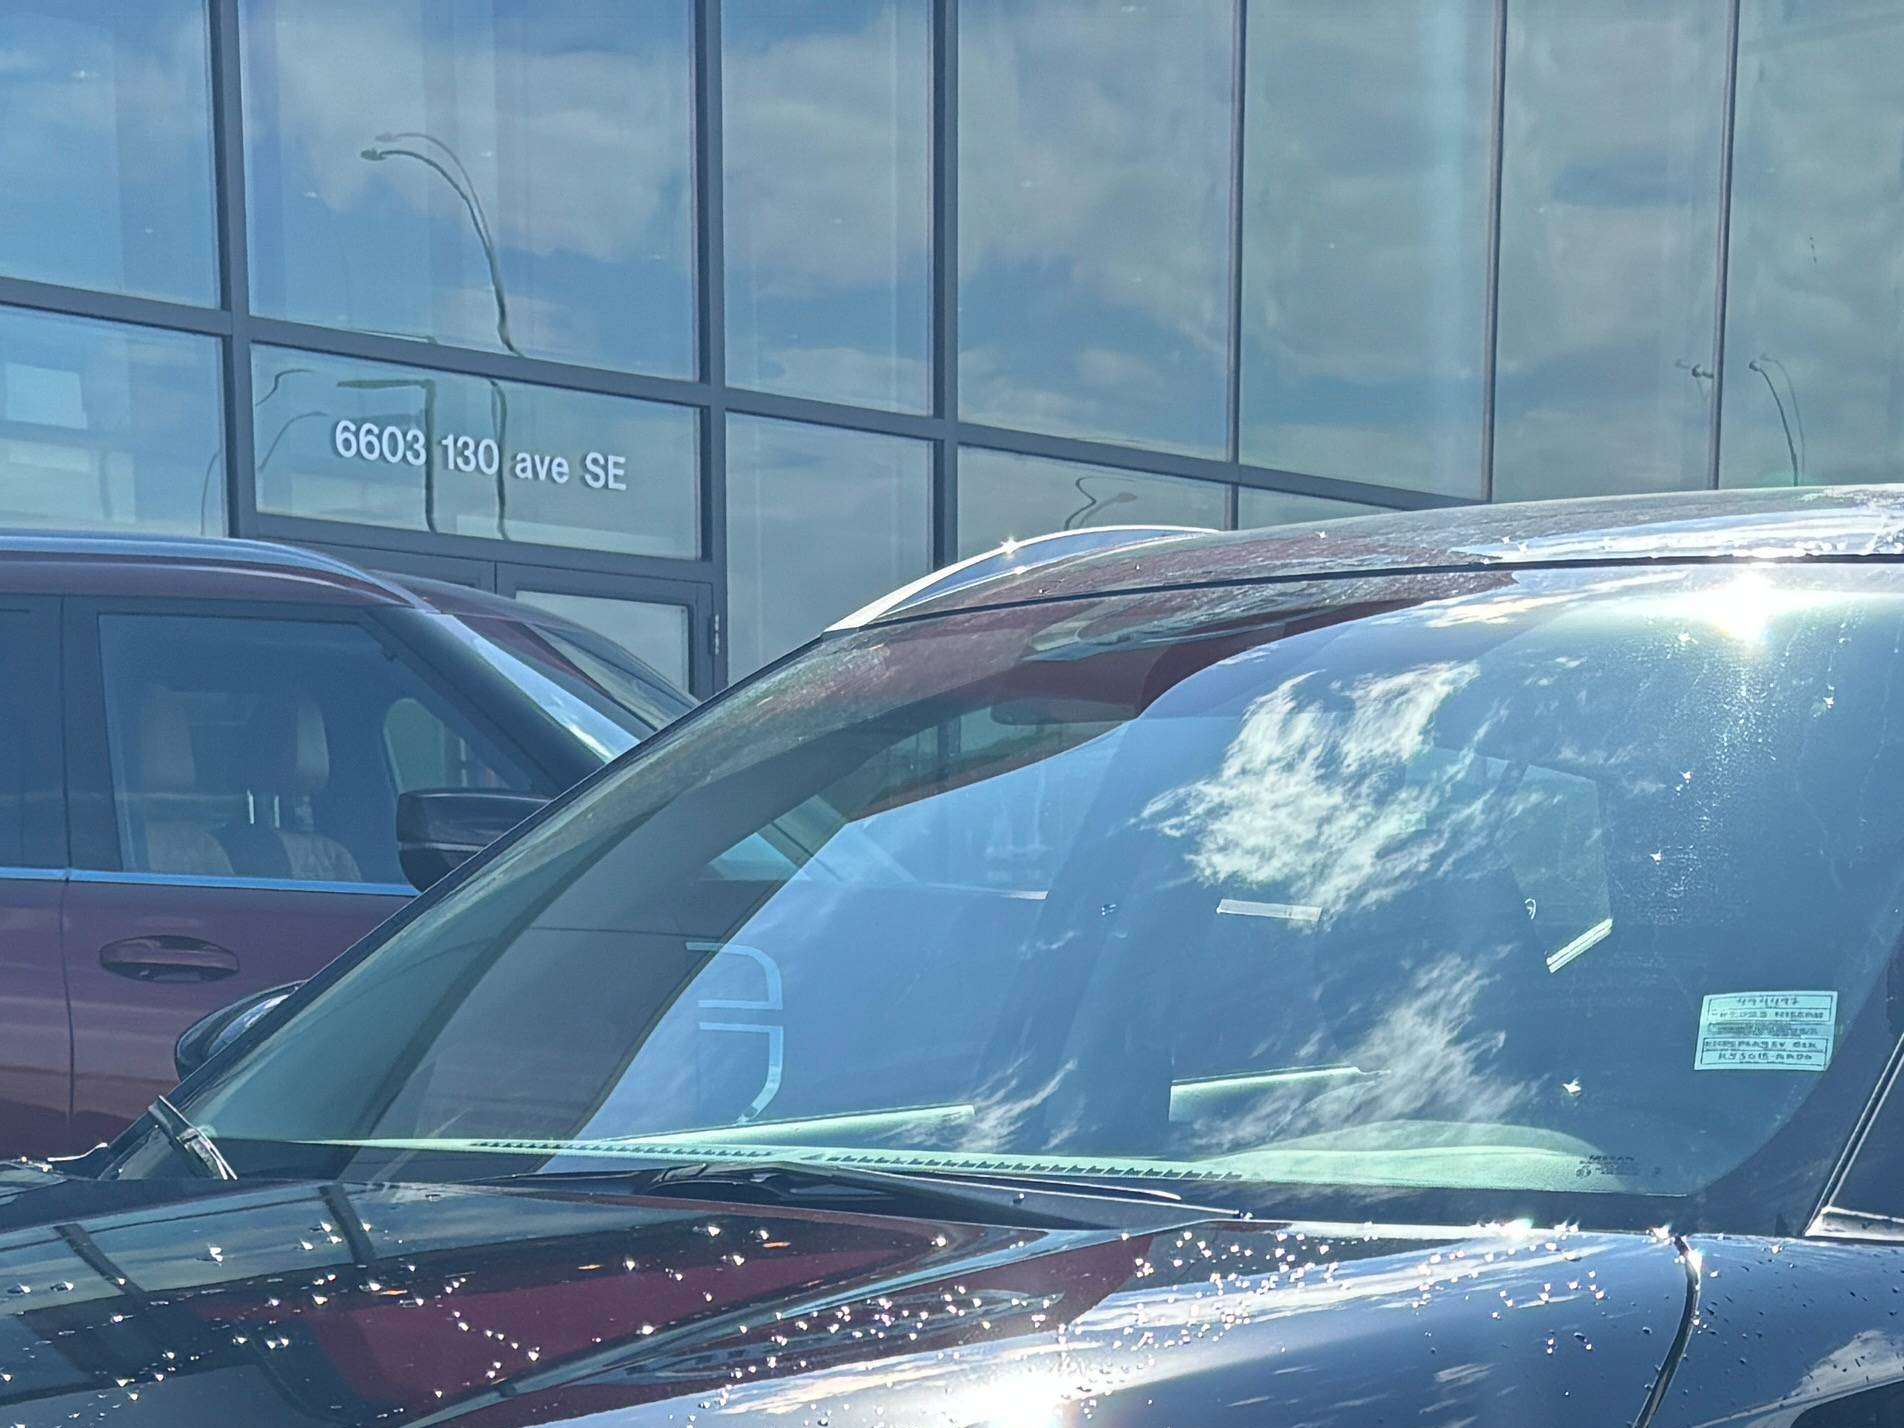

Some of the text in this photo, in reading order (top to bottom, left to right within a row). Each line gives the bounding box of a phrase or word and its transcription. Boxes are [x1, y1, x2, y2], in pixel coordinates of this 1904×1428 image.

[335, 420, 627, 491] 6603 130 ave SE
